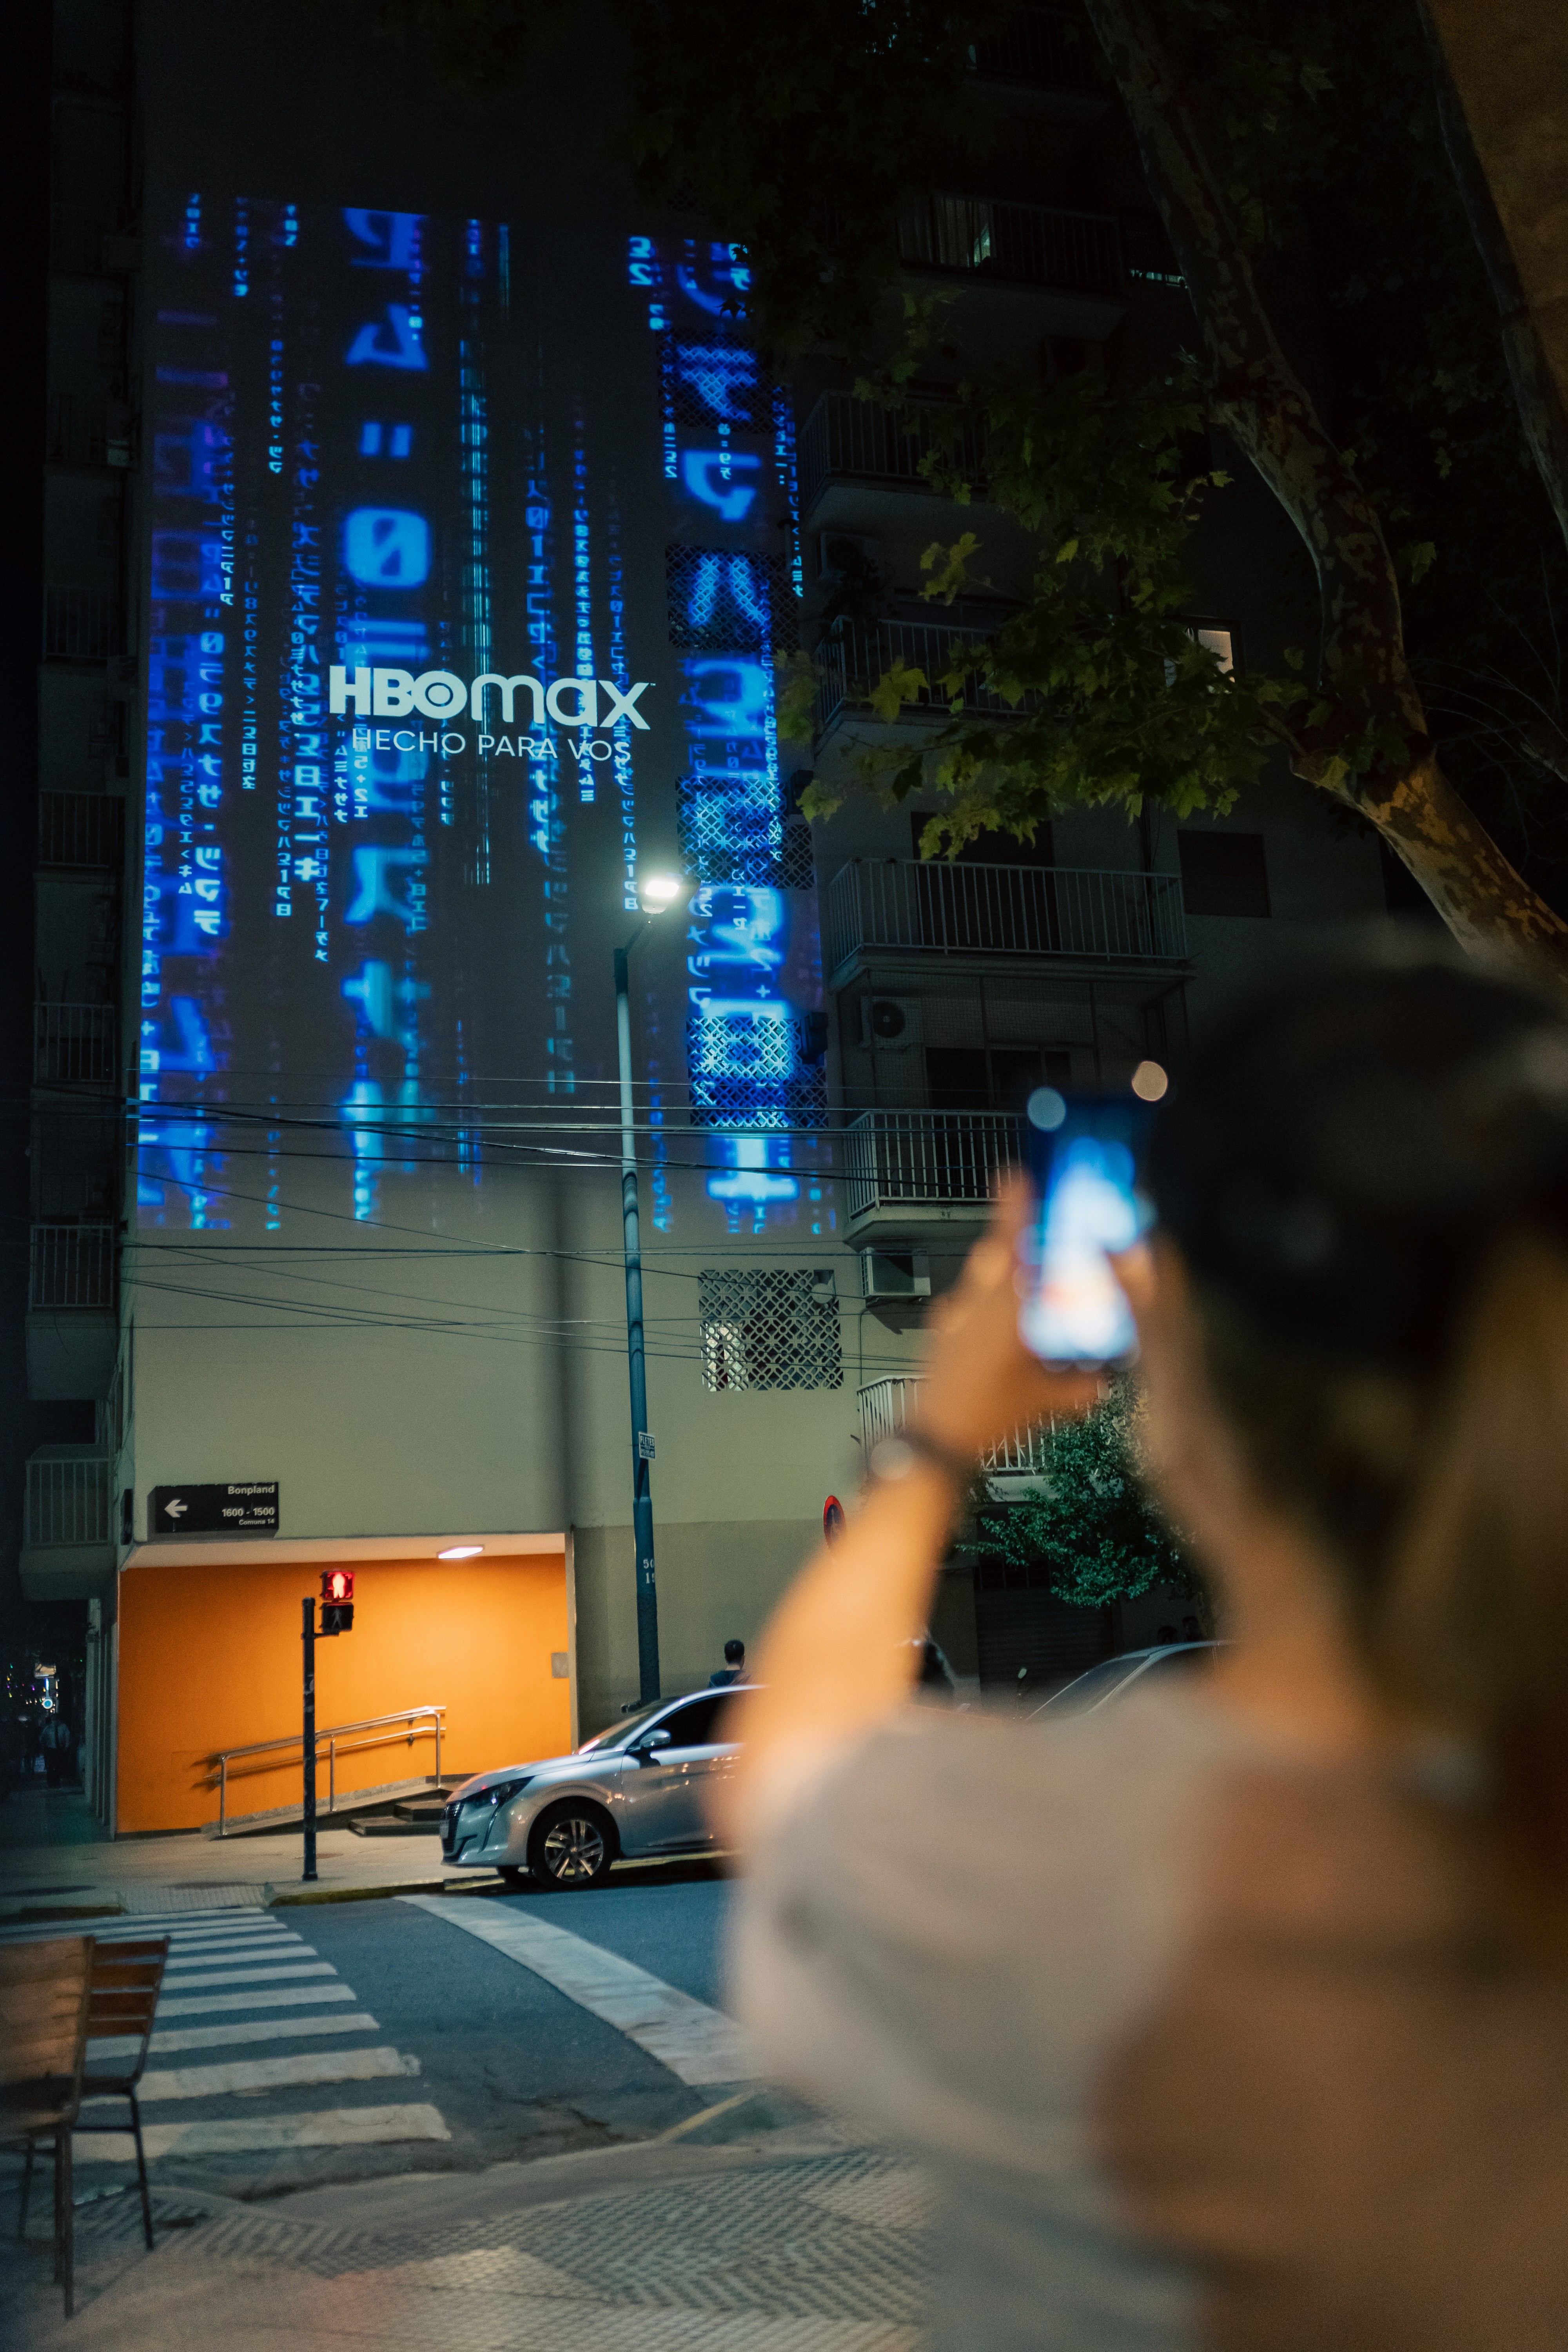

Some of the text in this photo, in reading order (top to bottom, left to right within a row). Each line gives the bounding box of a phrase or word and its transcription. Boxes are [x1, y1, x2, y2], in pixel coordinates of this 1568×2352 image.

[351, 728, 632, 762] HECHO PARA VOS
[640, 1436, 655, 1446] FLETES
[228, 1485, 274, 1496] Bonpland
[221, 1508, 244, 1517] 1600
[253, 1507, 274, 1516] 1500
